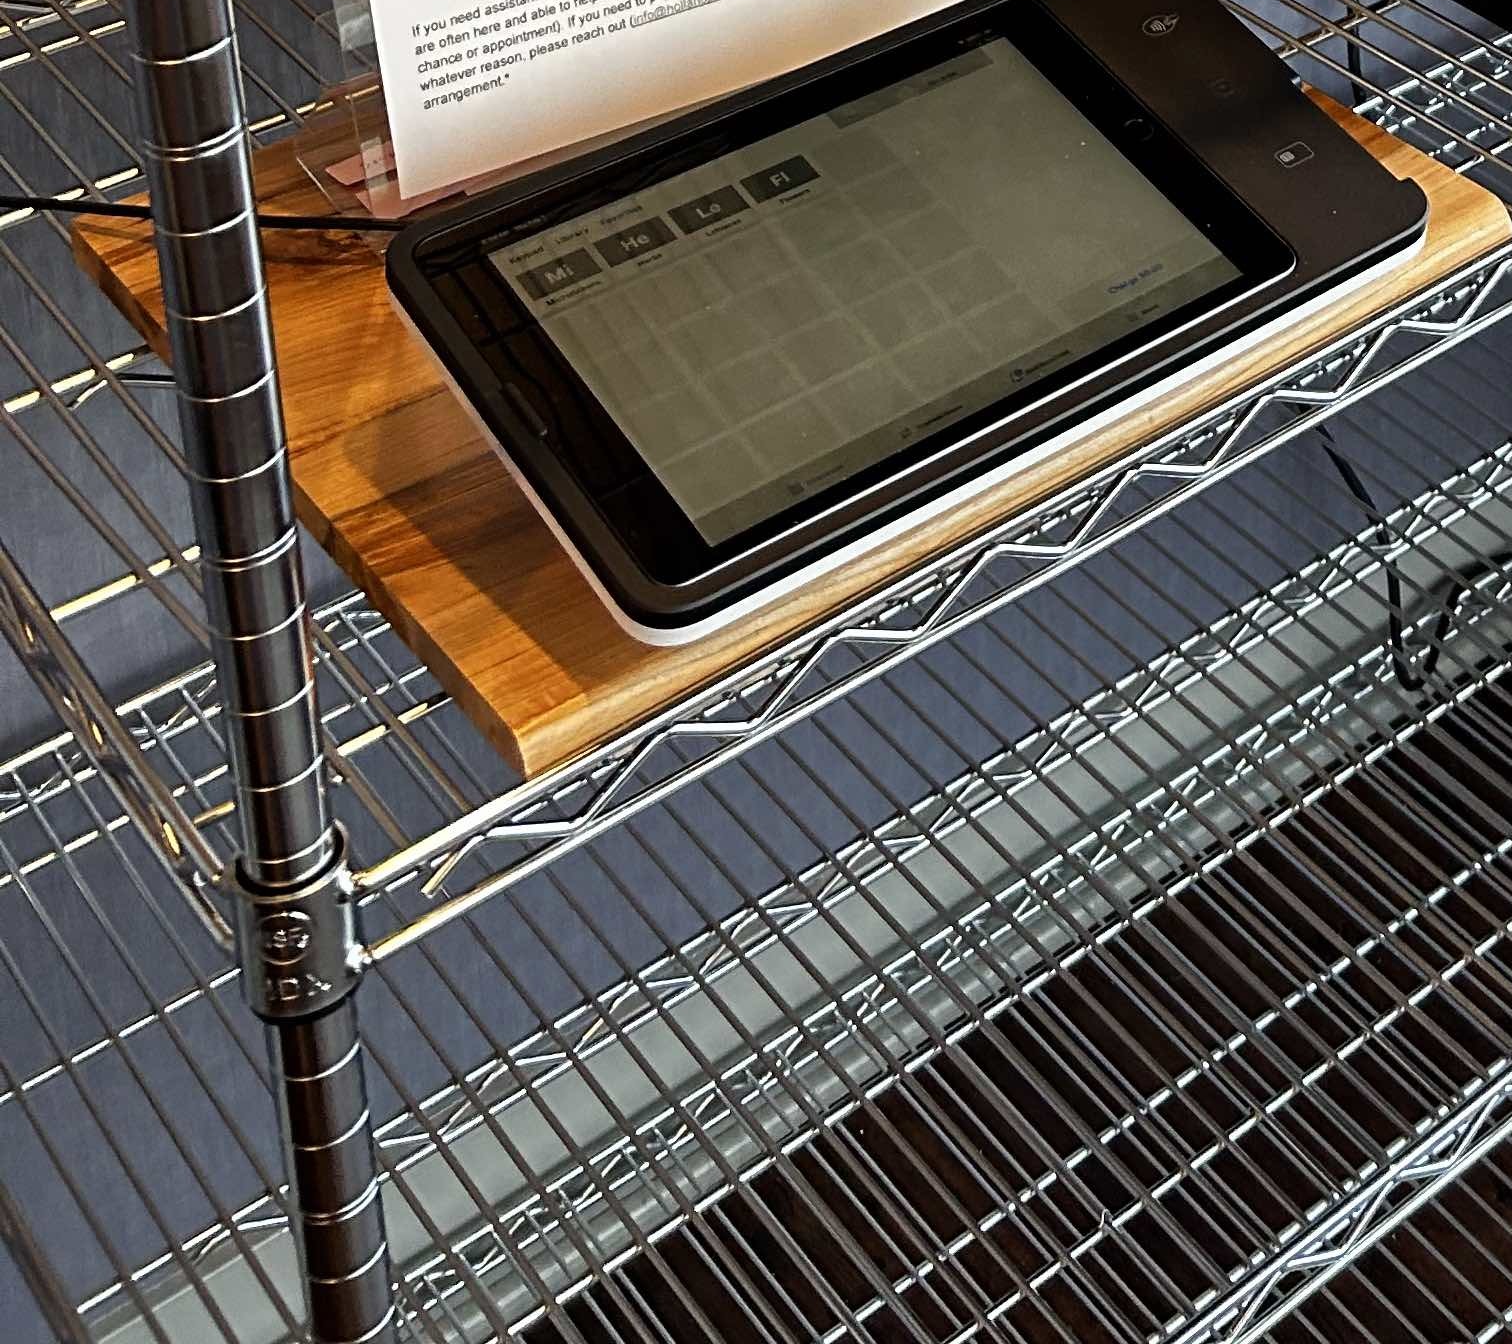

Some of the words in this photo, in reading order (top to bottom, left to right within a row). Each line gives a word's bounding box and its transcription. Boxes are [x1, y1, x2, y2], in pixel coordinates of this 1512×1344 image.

[411, 23, 420, 37] If
[422, 19, 446, 37] you
[449, 6, 480, 26] need
[543, 263, 575, 285] Mi
